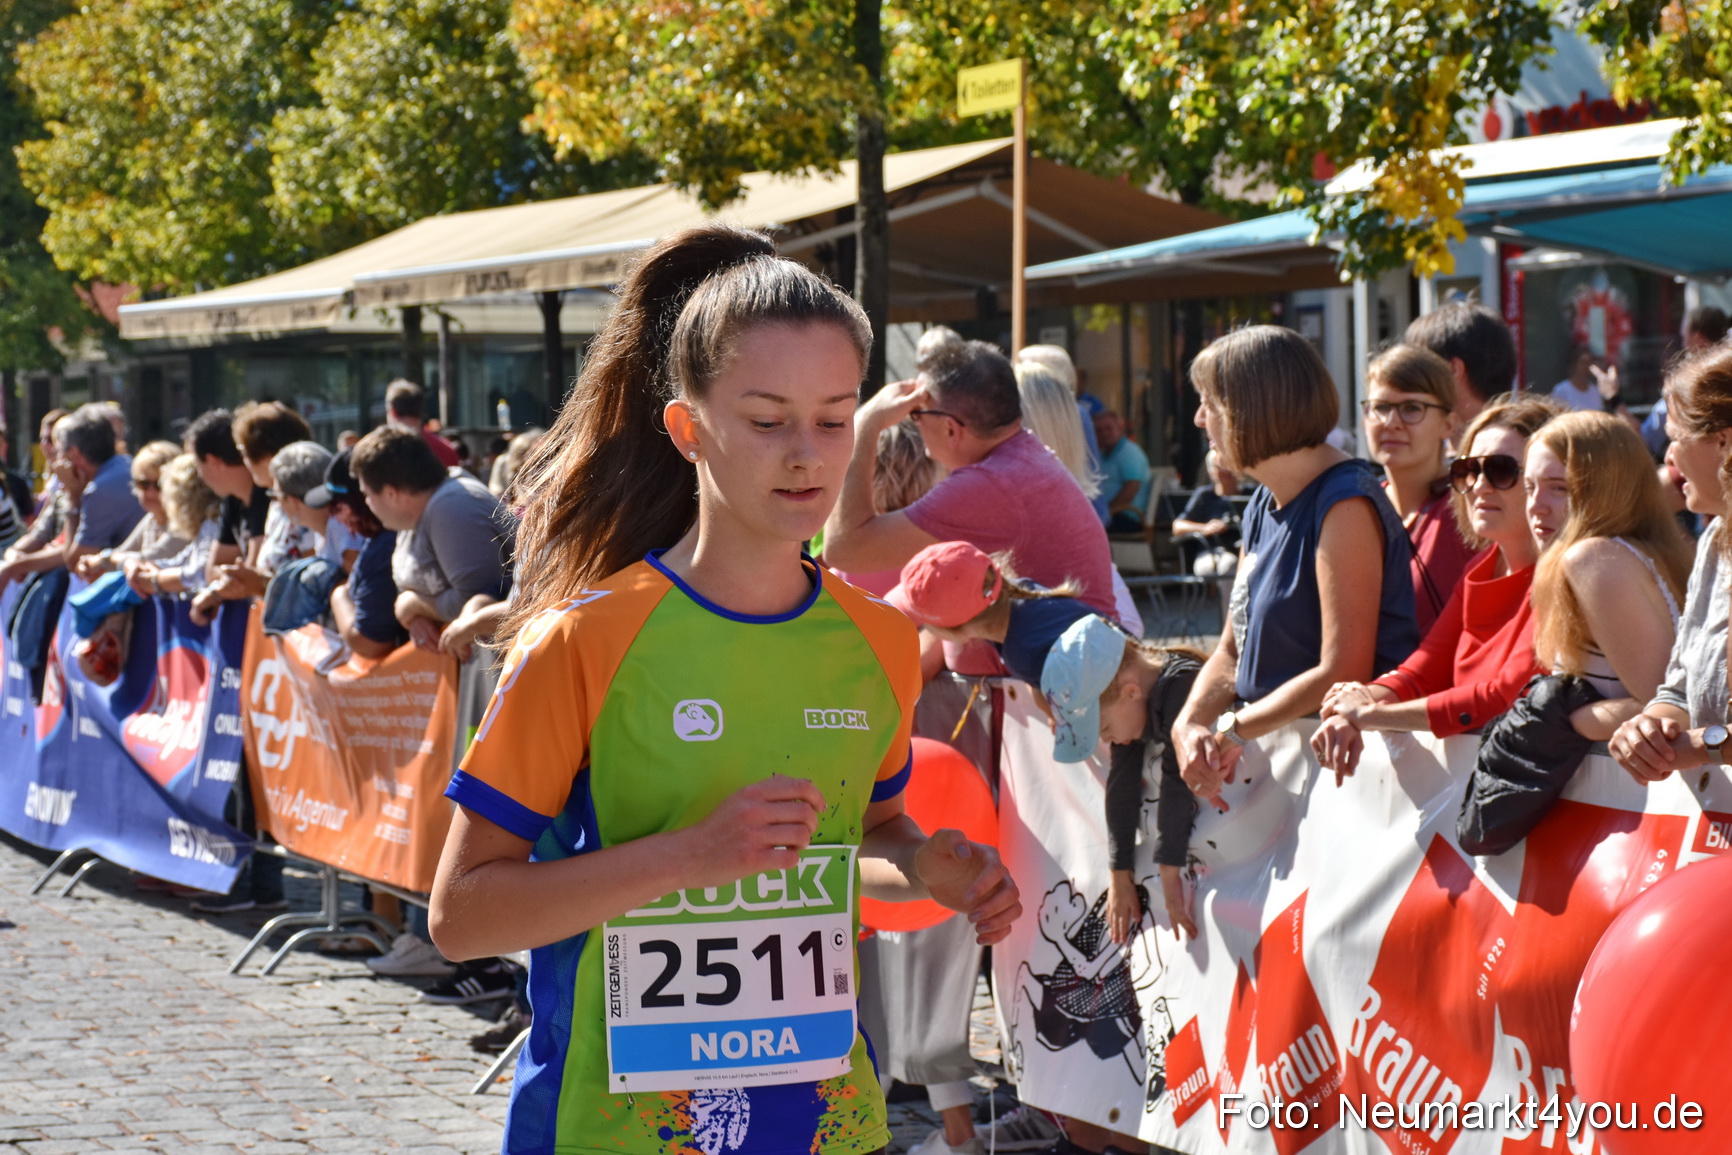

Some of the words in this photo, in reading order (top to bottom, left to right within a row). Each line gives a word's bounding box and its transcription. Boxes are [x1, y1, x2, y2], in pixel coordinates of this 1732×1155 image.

[804, 709, 870, 730] BOCK
[835, 934, 843, 946] C
[639, 931, 825, 1009] 2511
[1476, 973, 1488, 1000] Seit
[1483, 937, 1506, 972] 1929
[691, 1027, 800, 1061] NORA
[1257, 1023, 1337, 1117] Braun
[1347, 984, 1463, 1143] Braun
[1170, 1066, 1207, 1113] Braun
